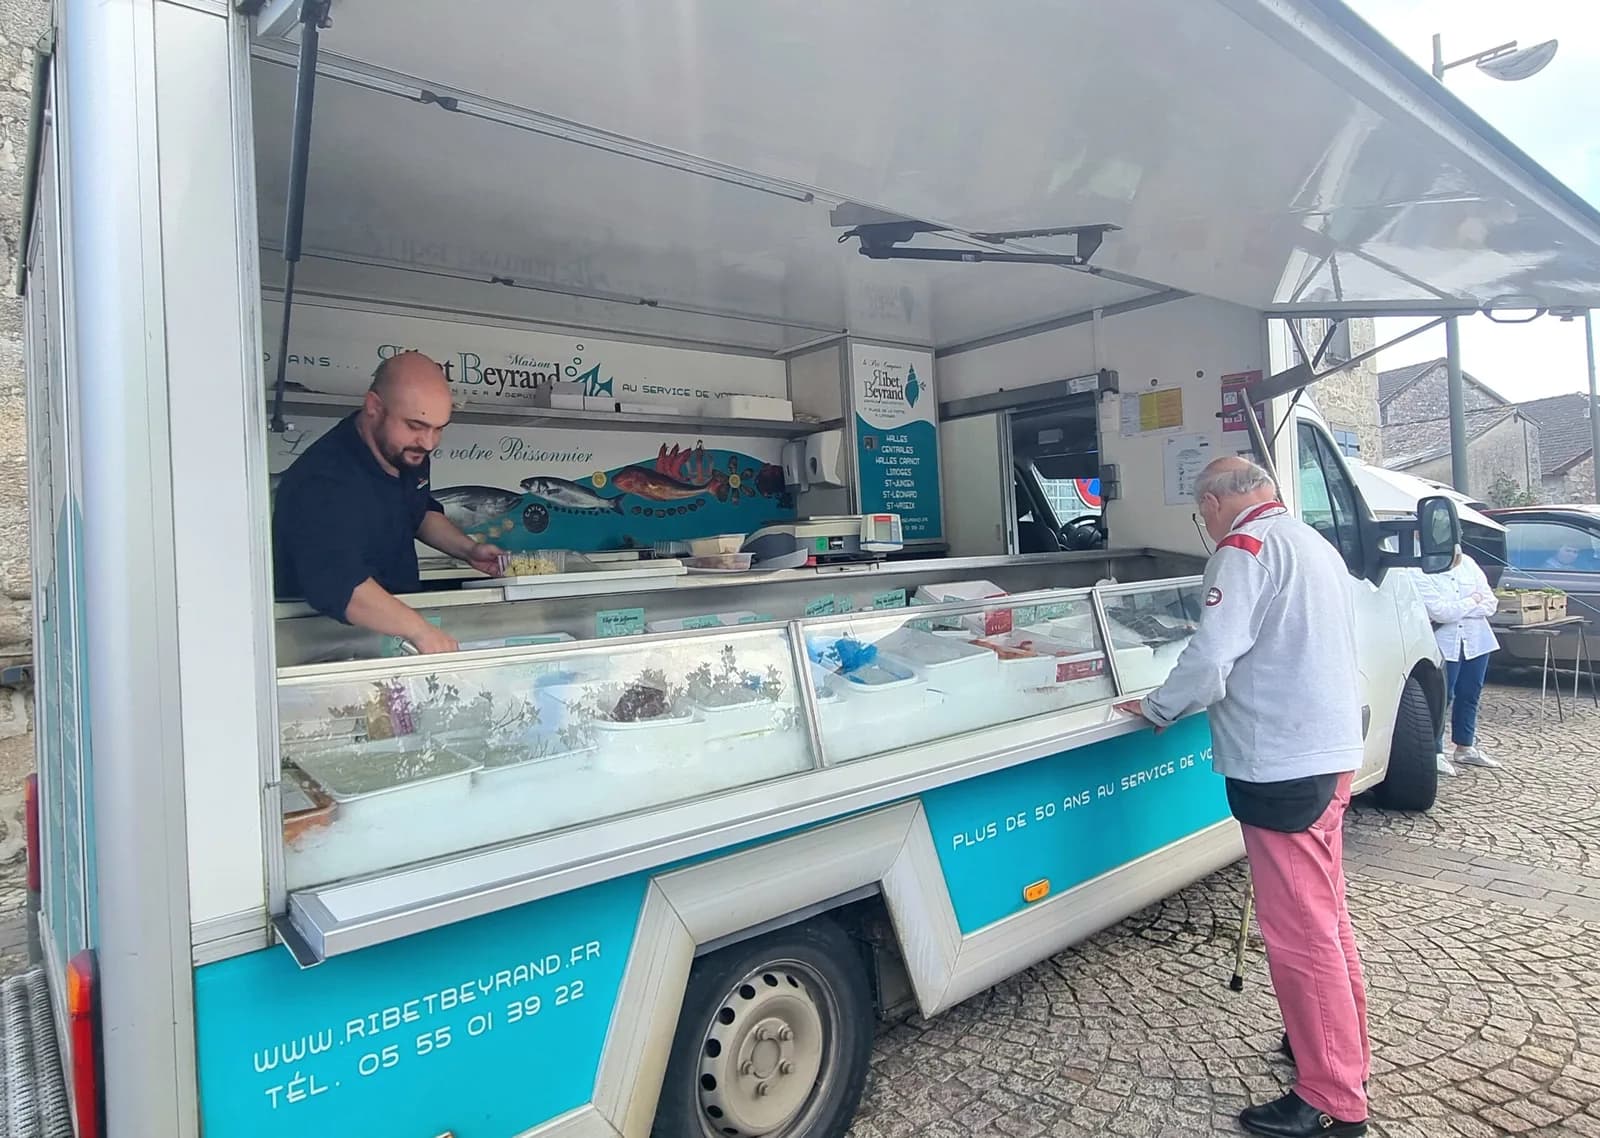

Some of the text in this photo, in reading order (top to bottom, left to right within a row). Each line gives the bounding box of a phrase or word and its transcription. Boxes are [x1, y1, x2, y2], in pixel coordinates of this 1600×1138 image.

[457, 351, 561, 396] Beyrand
[508, 354, 551, 369] Maison
[622, 383, 638, 393] AU
[642, 385, 691, 397] SERVICE
[695, 389, 710, 399] DE
[863, 380, 904, 403] Beyrand
[450, 443, 494, 461] votre
[499, 435, 593, 463] Poissonnier
[952, 822, 998, 851] PLUS
[1005, 811, 1028, 833] DE
[1034, 803, 1056, 821] 50
[1063, 790, 1091, 812] ANS
[1097, 782, 1115, 799] AU
[1120, 760, 1175, 791] SERVICE
[1179, 753, 1195, 770] DE
[253, 940, 601, 1074] WWW.RIBETBEYRAND.FR
[264, 979, 585, 1110] TÉL. 05 55 01 39 22
